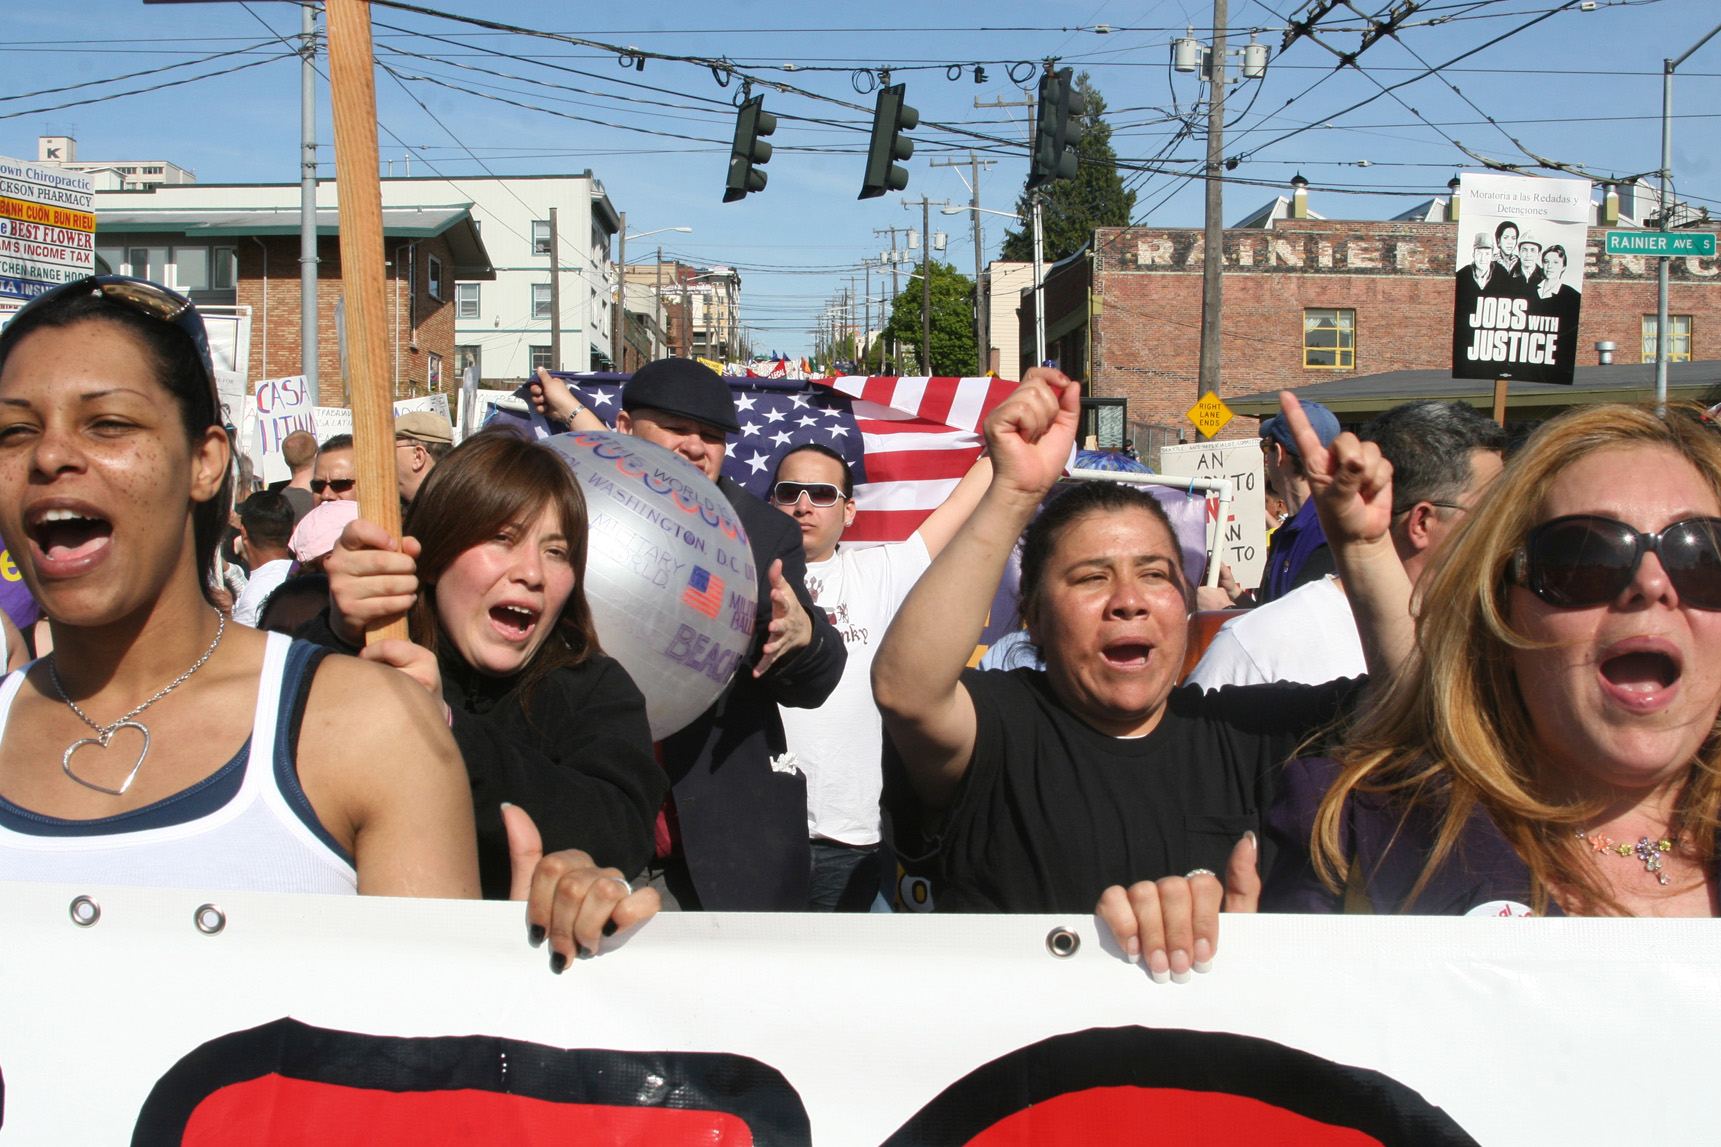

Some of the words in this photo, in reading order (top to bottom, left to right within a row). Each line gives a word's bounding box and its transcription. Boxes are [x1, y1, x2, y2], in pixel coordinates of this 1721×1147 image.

[26, 168, 91, 190] Chiropractic
[37, 187, 92, 207] PHARMACY
[1520, 192, 1531, 202] las
[1533, 193, 1571, 204] Redadas
[1573, 196, 1580, 206] y
[10, 221, 40, 240] BEST
[43, 227, 93, 249] FLOWER
[1611, 236, 1667, 249] RAINIER
[1673, 239, 1693, 249] AVE
[1703, 239, 1711, 249] S
[0, 239, 20, 253] M'S
[24, 243, 66, 260] INCOME
[70, 250, 91, 264] TAX
[0, 261, 27, 276] CHEN
[30, 265, 61, 281] RANGE
[1469, 296, 1528, 330] JOBS
[1528, 315, 1560, 332] WITH
[1467, 329, 1558, 365] JUSTICE
[256, 377, 311, 413] CASA
[1197, 450, 1224, 470] AN
[653, 467, 715, 512] WORLD
[1230, 472, 1255, 491] TO
[1230, 546, 1255, 563] TO
[664, 622, 743, 685] BEACH
